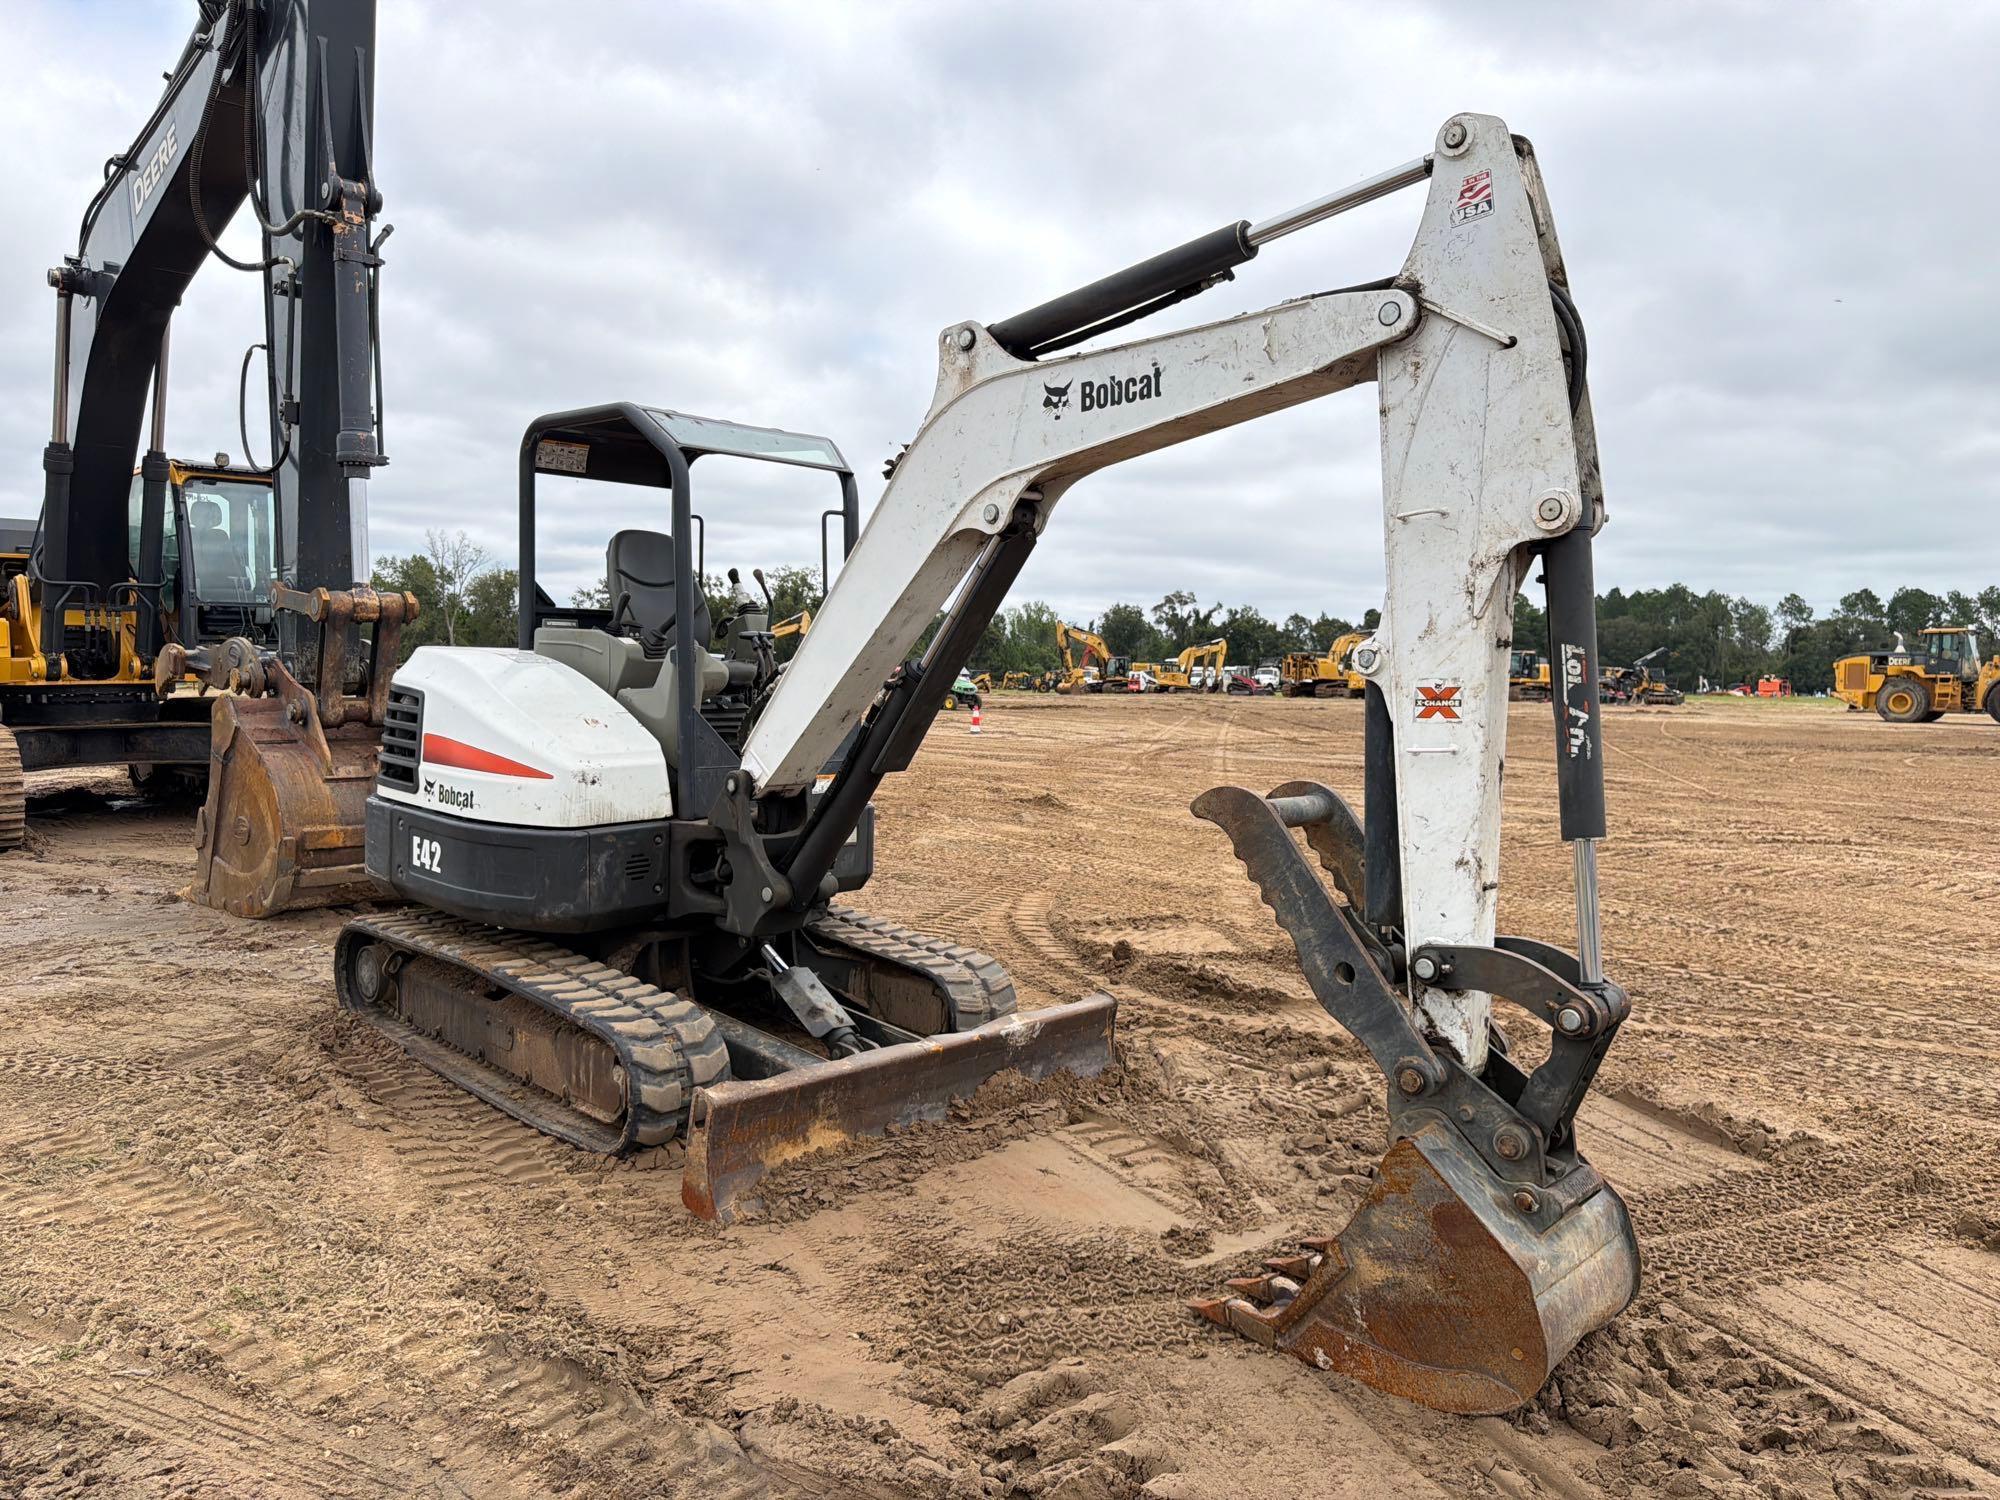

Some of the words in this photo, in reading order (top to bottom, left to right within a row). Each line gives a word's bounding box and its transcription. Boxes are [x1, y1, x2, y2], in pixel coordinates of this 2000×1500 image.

[133, 122, 178, 216] DEERE
[1080, 366, 1162, 412] Bobcat
[438, 784, 474, 809] Bobcat
[412, 835, 442, 874] E42
